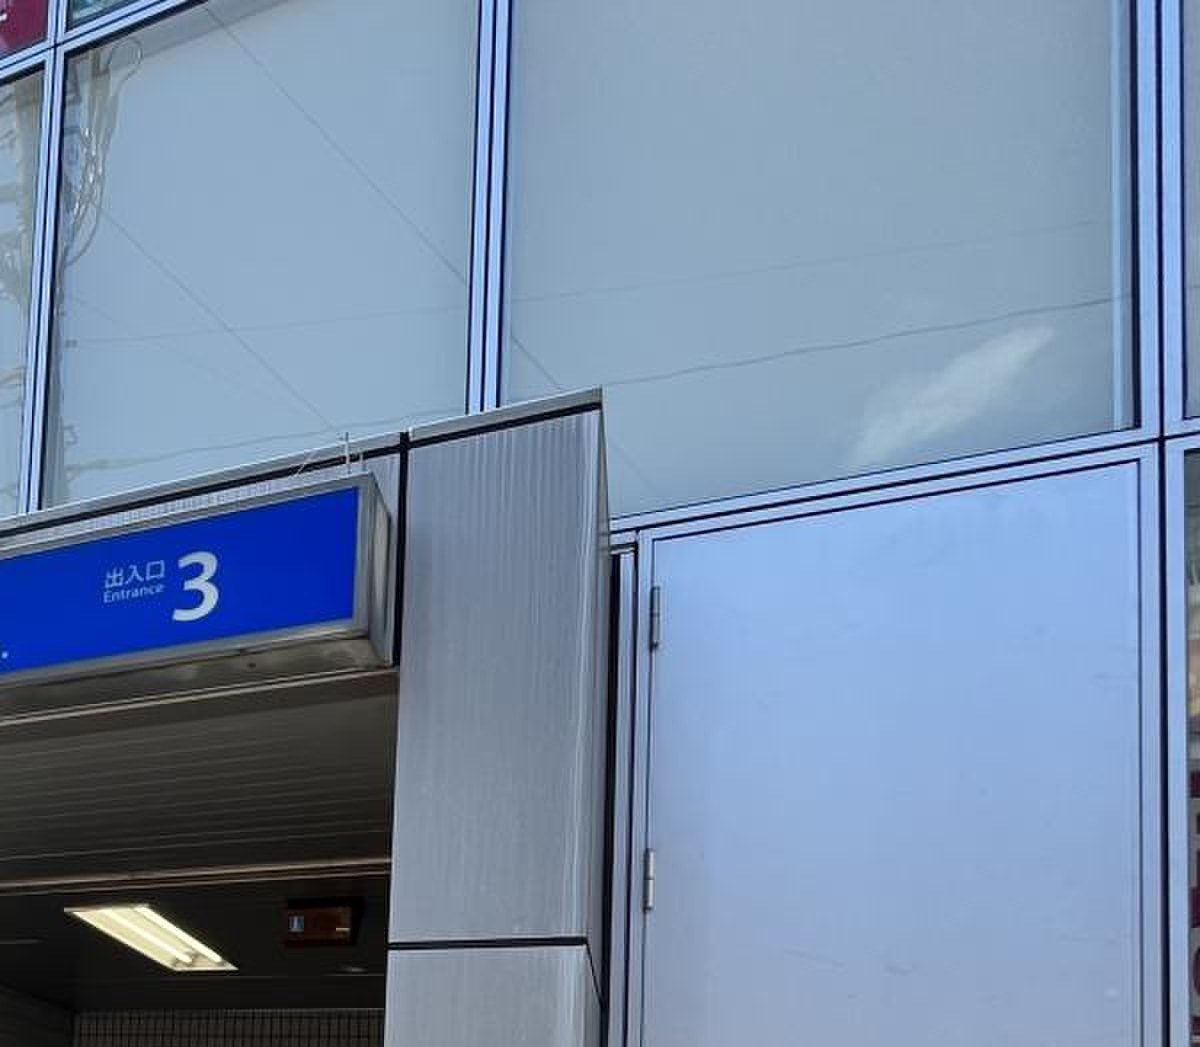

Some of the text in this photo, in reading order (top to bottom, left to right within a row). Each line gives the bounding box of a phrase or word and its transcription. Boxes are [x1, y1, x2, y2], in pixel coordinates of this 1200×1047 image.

[104, 559, 165, 588] 出入口
[171, 550, 220, 622] 3
[103, 583, 165, 604] Entrance
